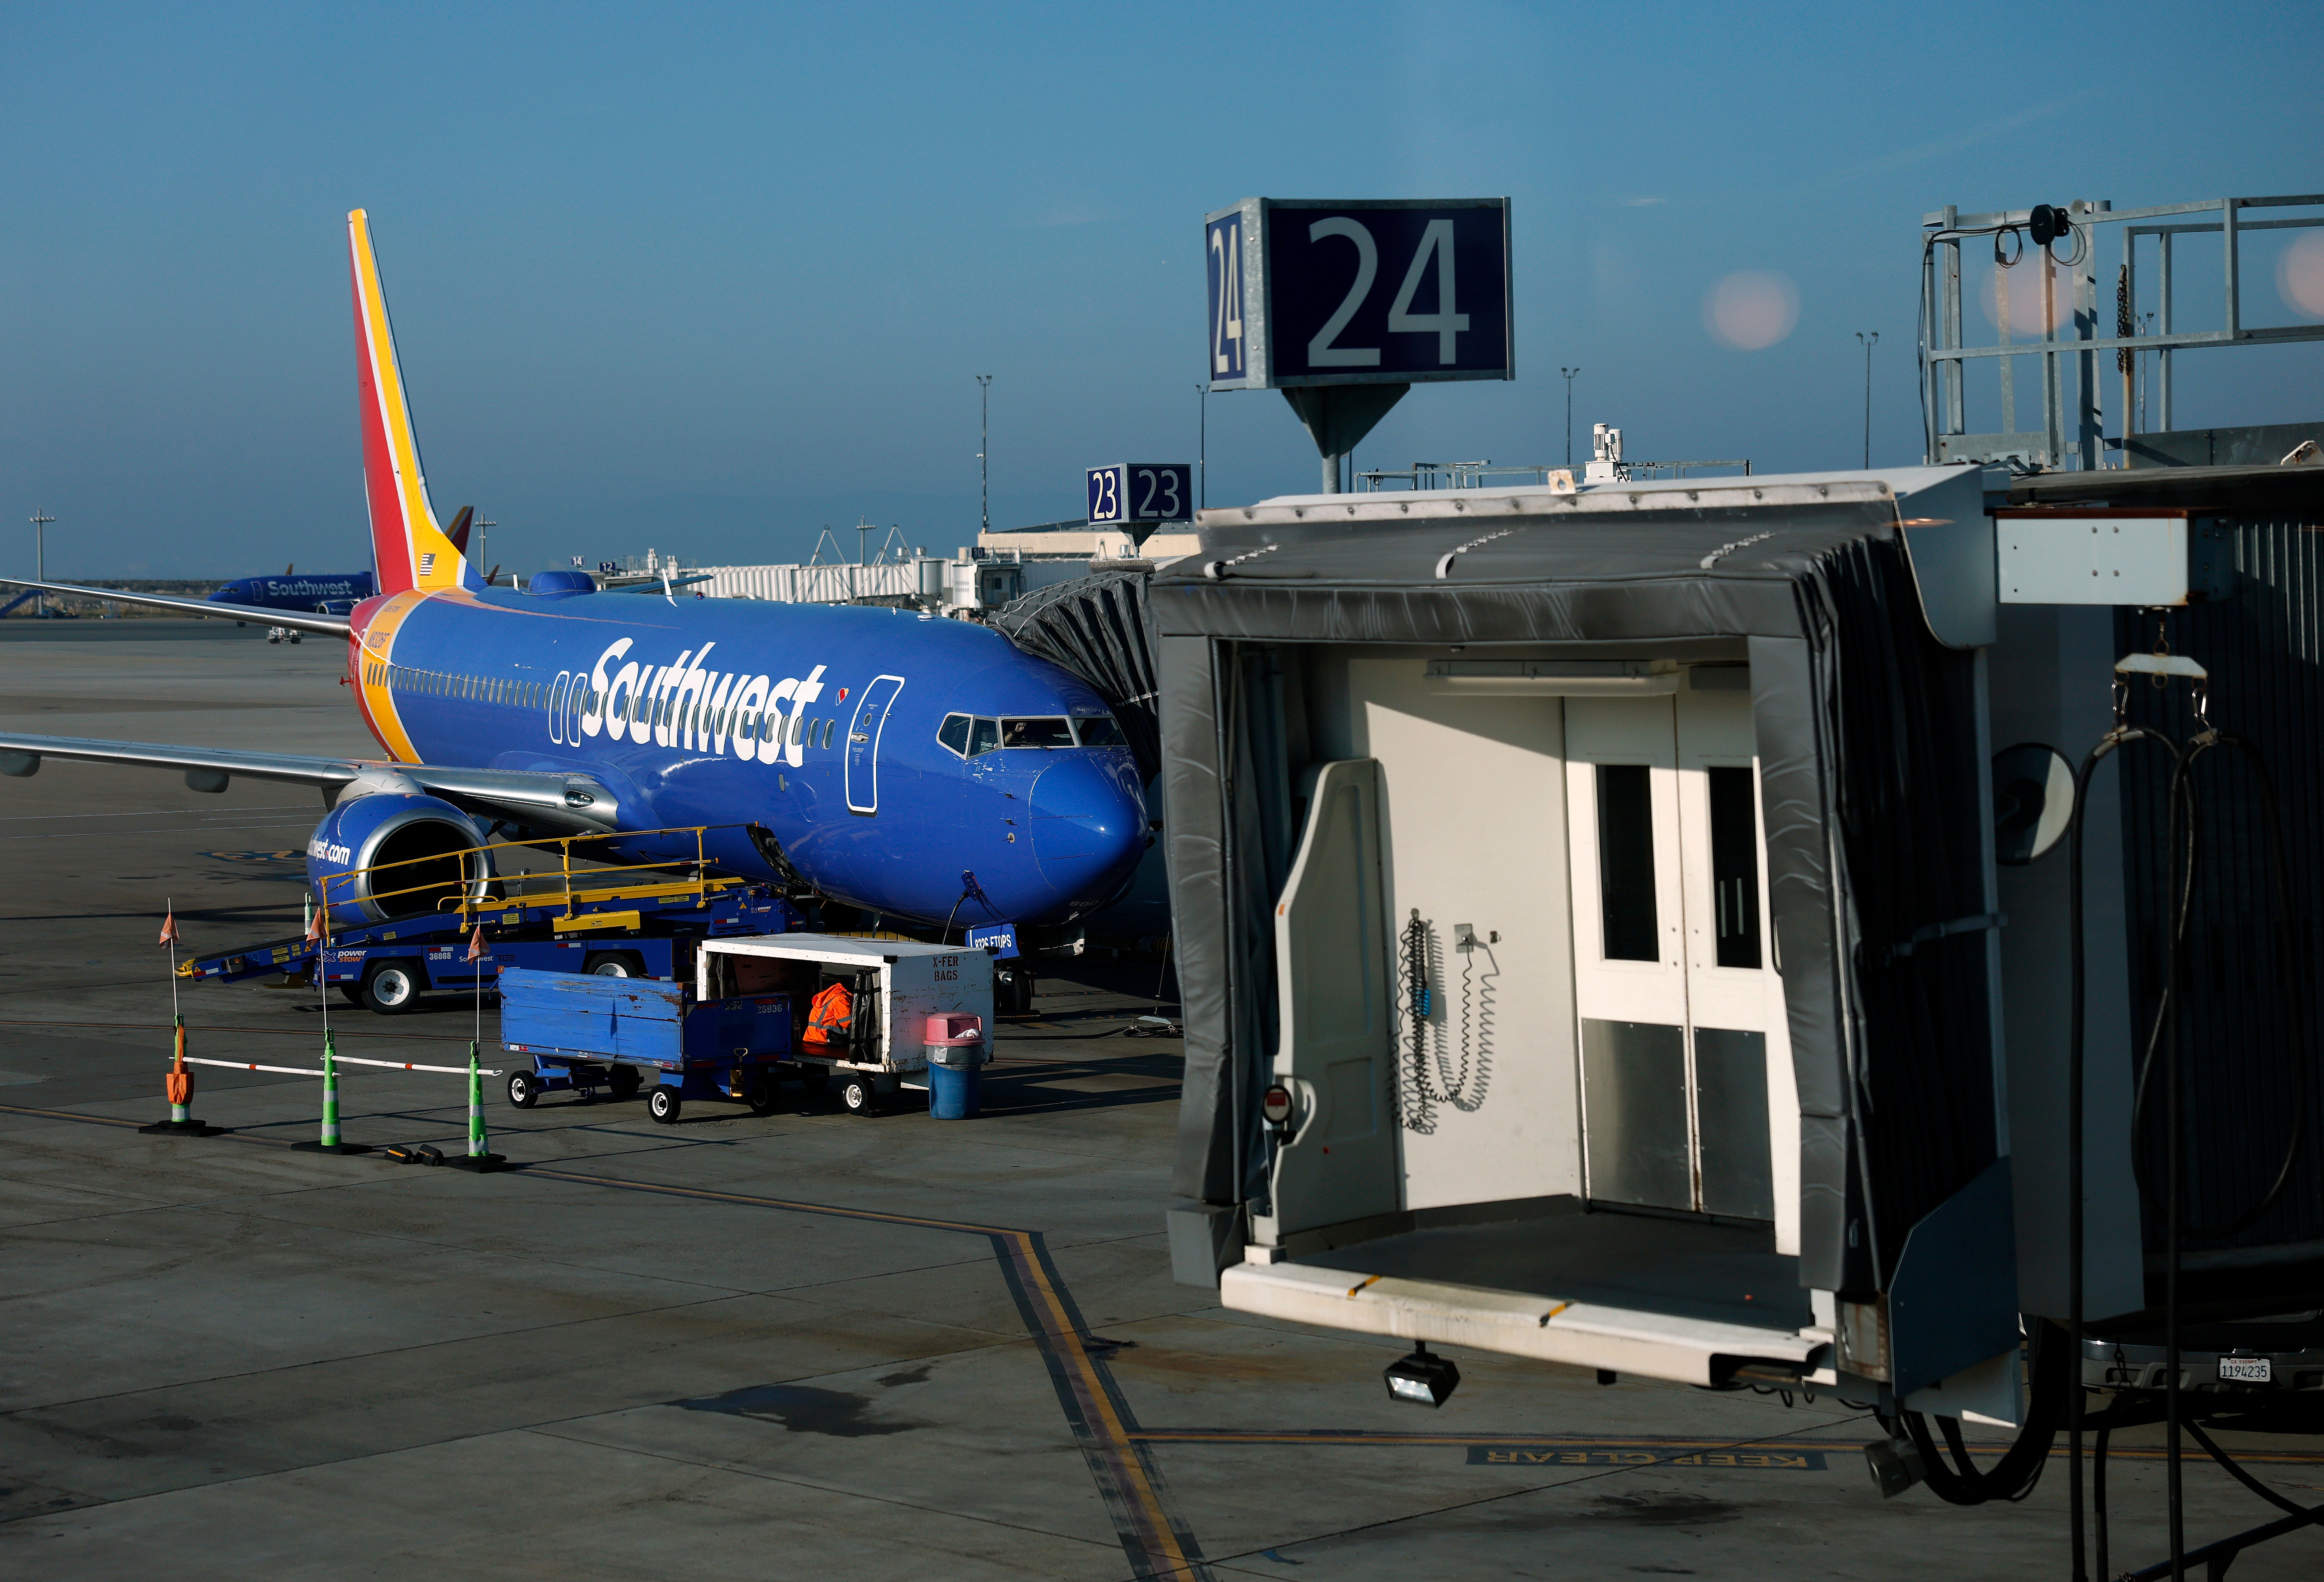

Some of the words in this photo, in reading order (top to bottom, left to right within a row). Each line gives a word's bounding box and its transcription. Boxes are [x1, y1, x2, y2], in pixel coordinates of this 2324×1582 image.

[1308, 217, 1469, 367] 24
[1212, 224, 1242, 373] 24
[1093, 471, 1117, 519] 23
[1139, 469, 1179, 517] 23
[974, 549, 982, 557] 10
[573, 557, 582, 566] 14
[603, 562, 612, 571] 12
[268, 579, 353, 596] Southwest
[582, 638, 828, 767] Southwest
[338, 950, 367, 958] power
[429, 952, 451, 960] 36088
[933, 956, 958, 968] X-FER
[934, 970, 958, 981] BAGS
[2221, 1365, 2267, 1377] 1194235
